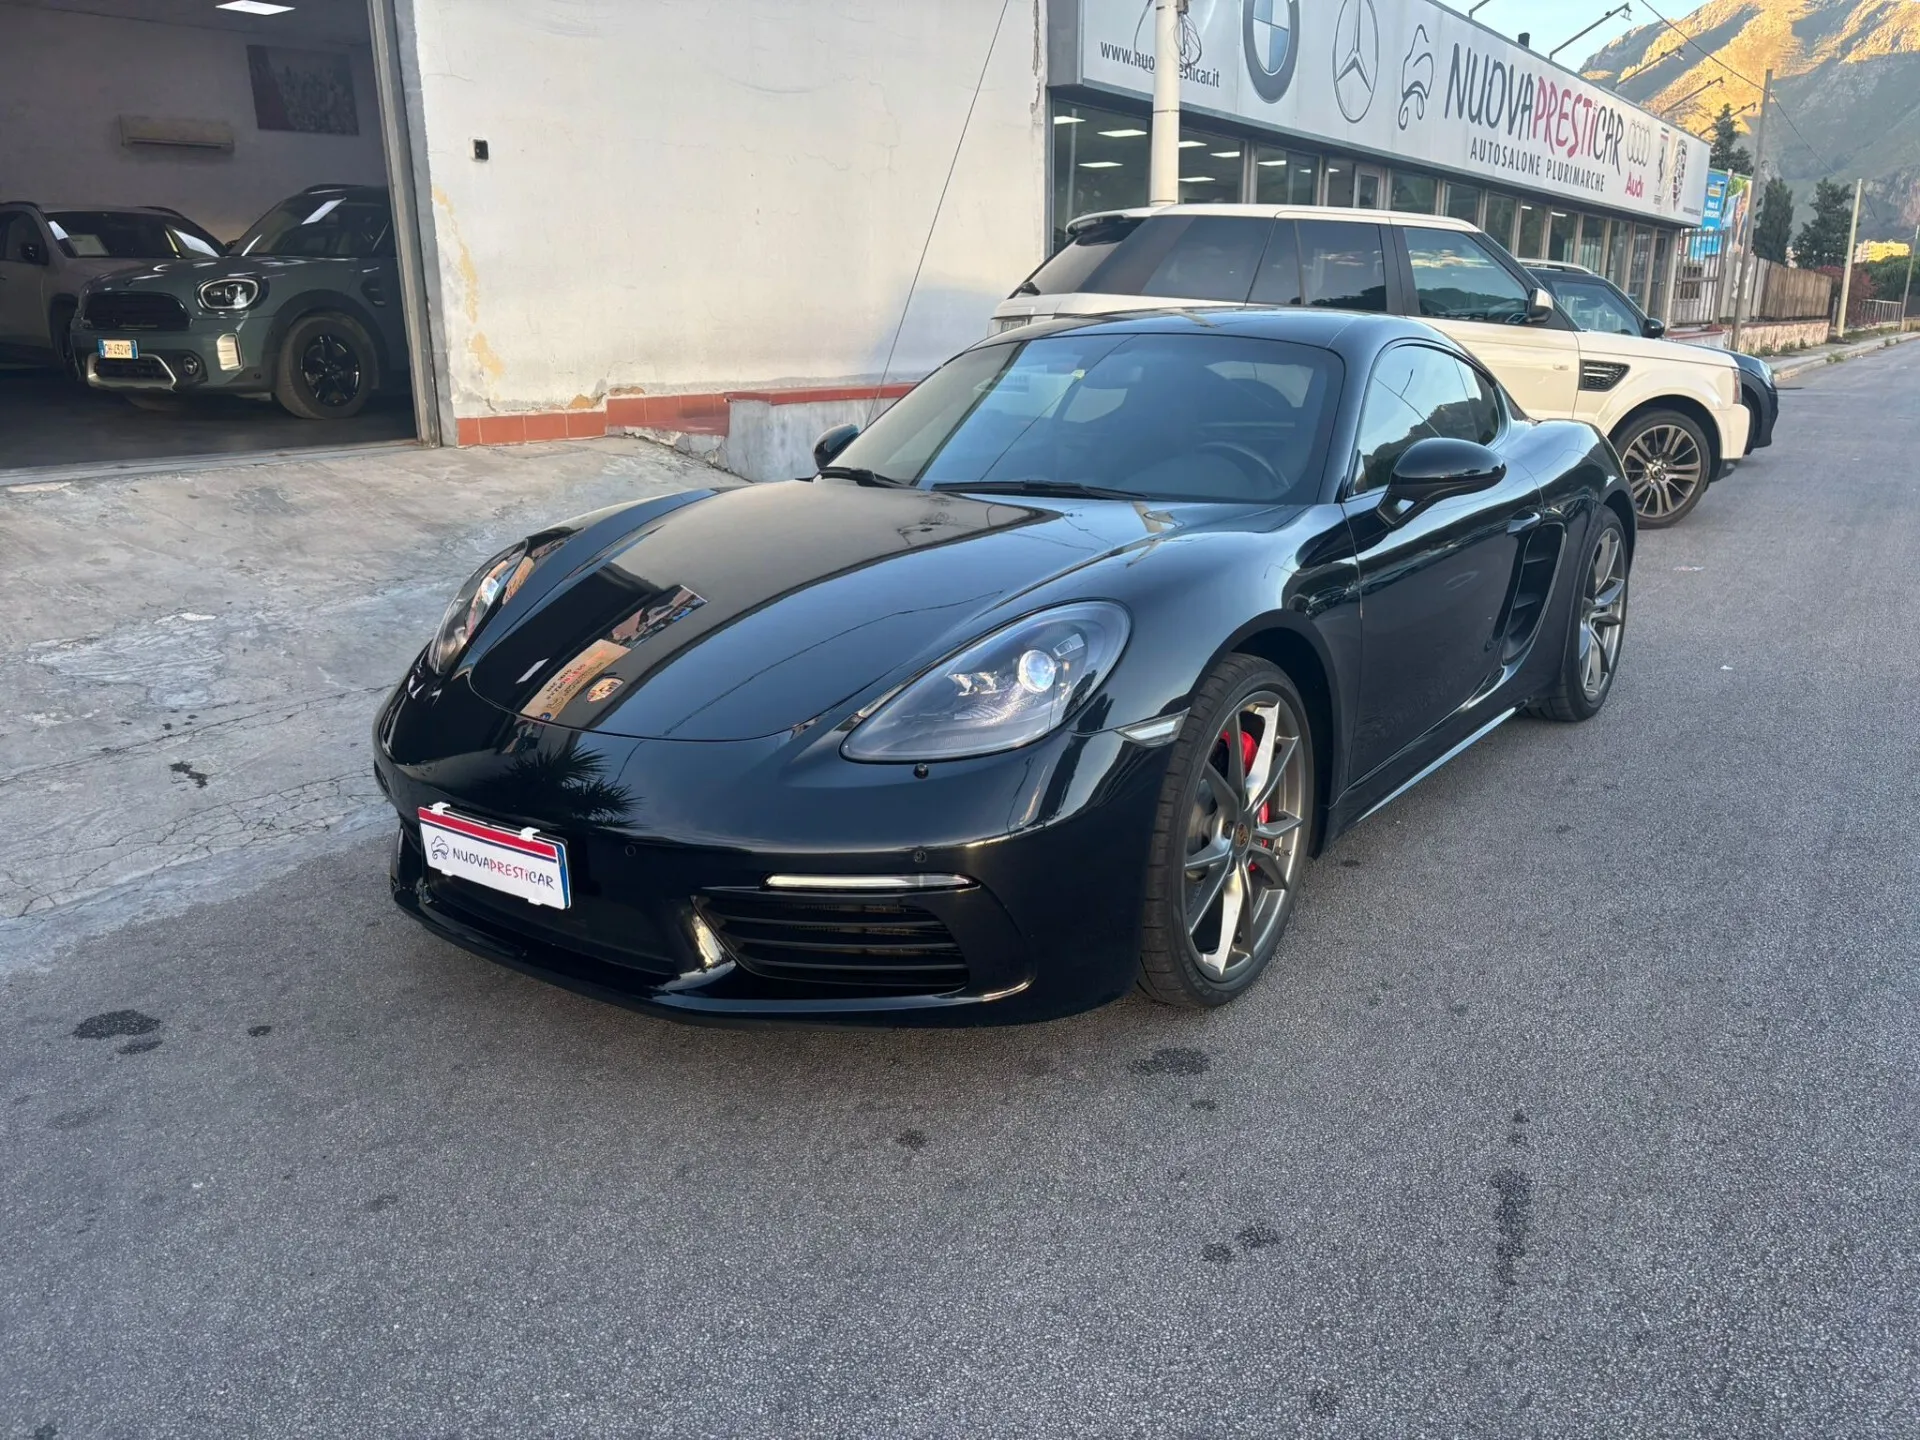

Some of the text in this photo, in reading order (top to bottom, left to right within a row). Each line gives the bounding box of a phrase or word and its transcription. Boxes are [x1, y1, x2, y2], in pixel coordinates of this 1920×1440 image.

[1470, 137, 1605, 193] AUTOSALONE PLURIMARCHE
[1624, 171, 1645, 198] Audi
